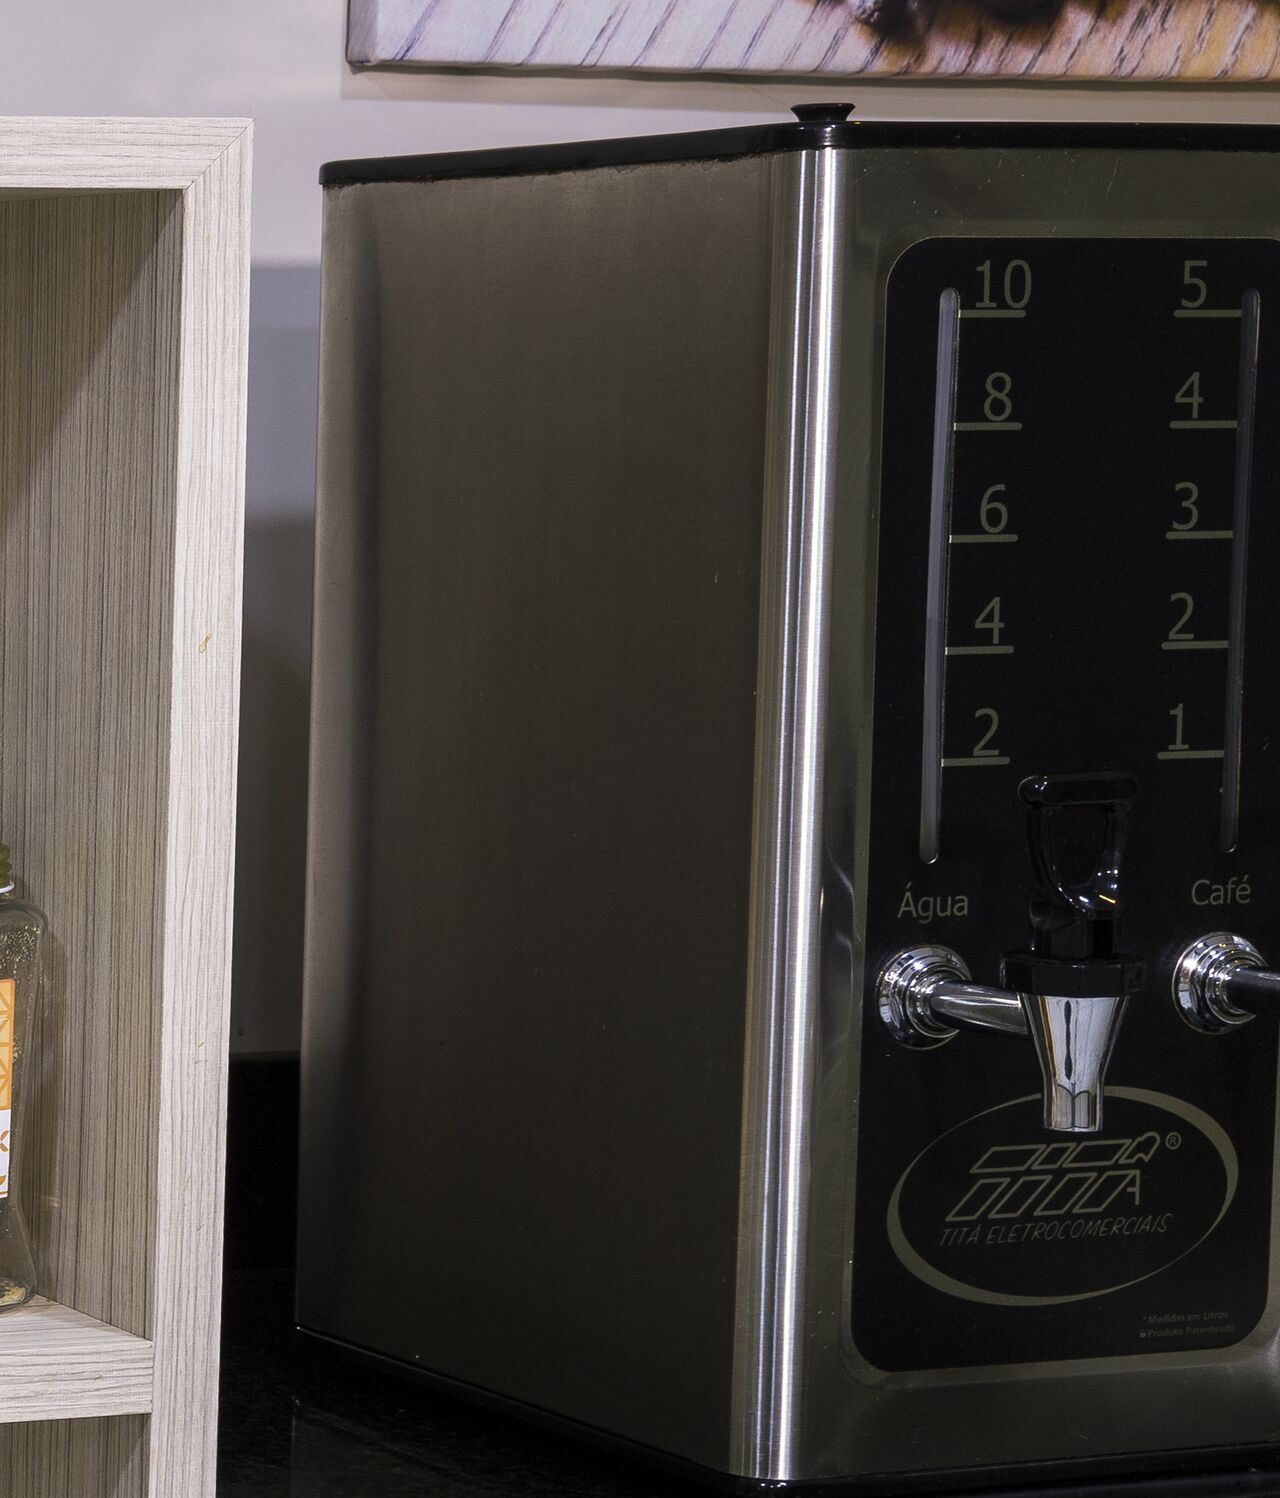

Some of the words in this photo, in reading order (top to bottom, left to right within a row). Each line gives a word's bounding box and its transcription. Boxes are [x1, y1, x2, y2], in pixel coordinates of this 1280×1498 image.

[975, 259, 1032, 309] 10
[1180, 260, 1208, 309] 5
[983, 372, 1013, 421] 8
[1174, 372, 1204, 419] 4
[979, 485, 1008, 534] 6
[1172, 481, 1199, 531] 3
[975, 597, 1005, 645] 4
[1168, 592, 1195, 640] 2
[972, 708, 1000, 757] 2
[1168, 703, 1189, 750] 1
[897, 882, 969, 924] Água
[1191, 876, 1252, 906] Café
[986, 1213, 1173, 1245] ELETROCOMERCIAIS
